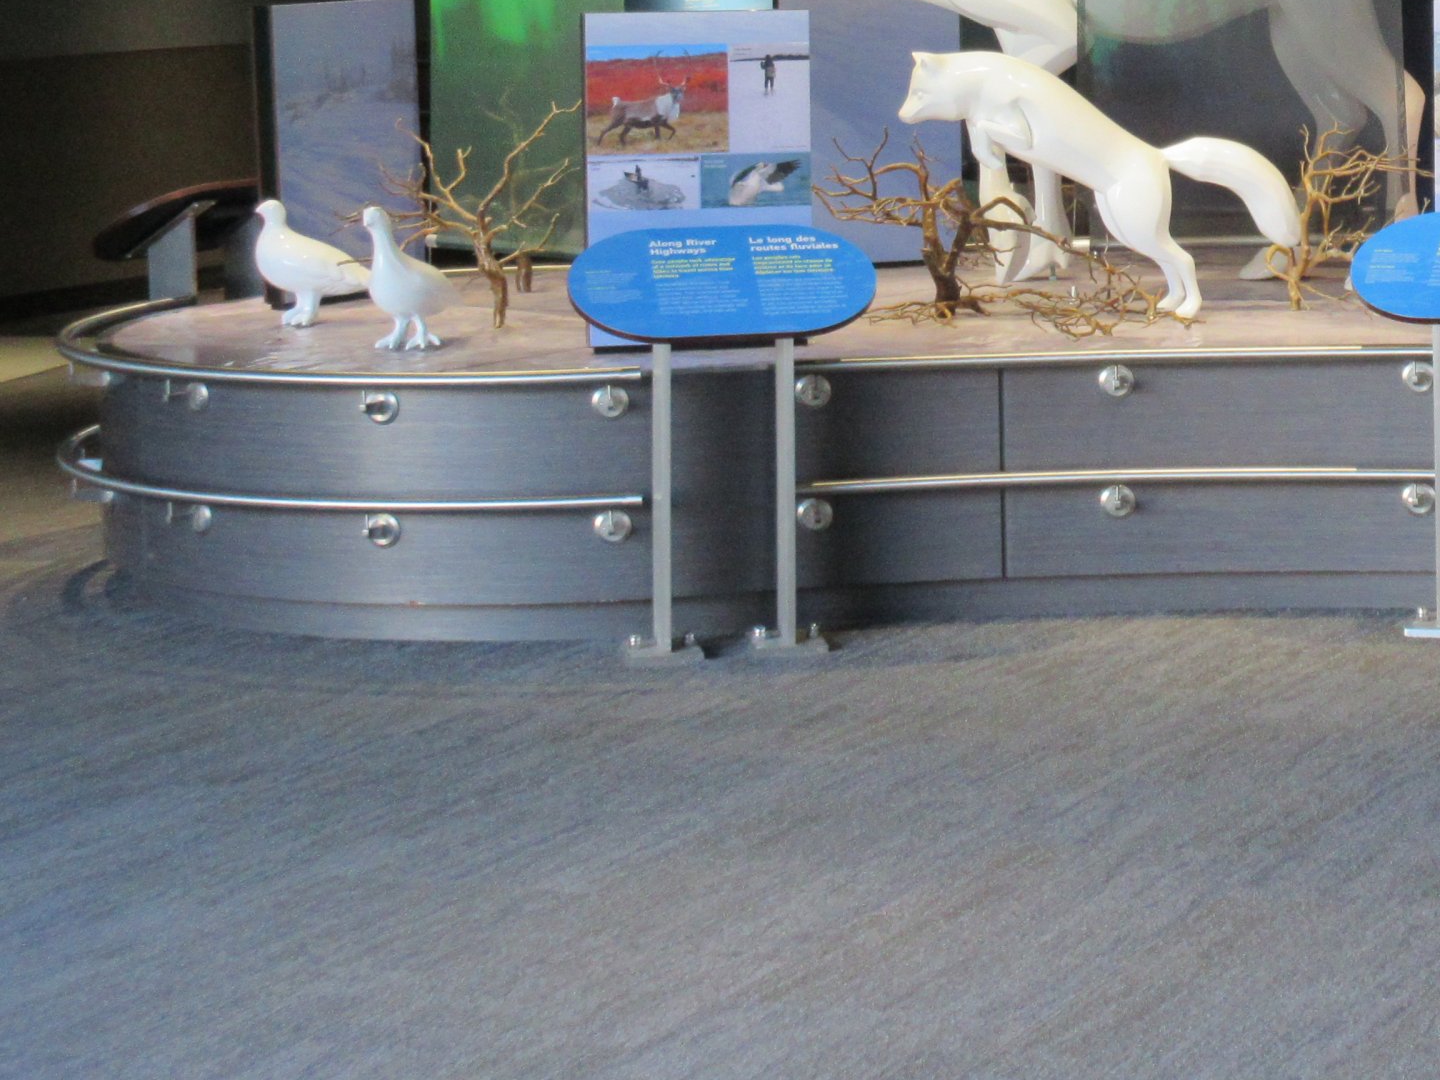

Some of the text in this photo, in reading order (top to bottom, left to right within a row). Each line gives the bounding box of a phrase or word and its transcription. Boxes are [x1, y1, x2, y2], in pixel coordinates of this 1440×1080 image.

[649, 240, 682, 248] Along
[749, 236, 763, 244] Le
[766, 236, 792, 244] long
[790, 242, 838, 250] fluviales
[650, 248, 707, 256] Highways
